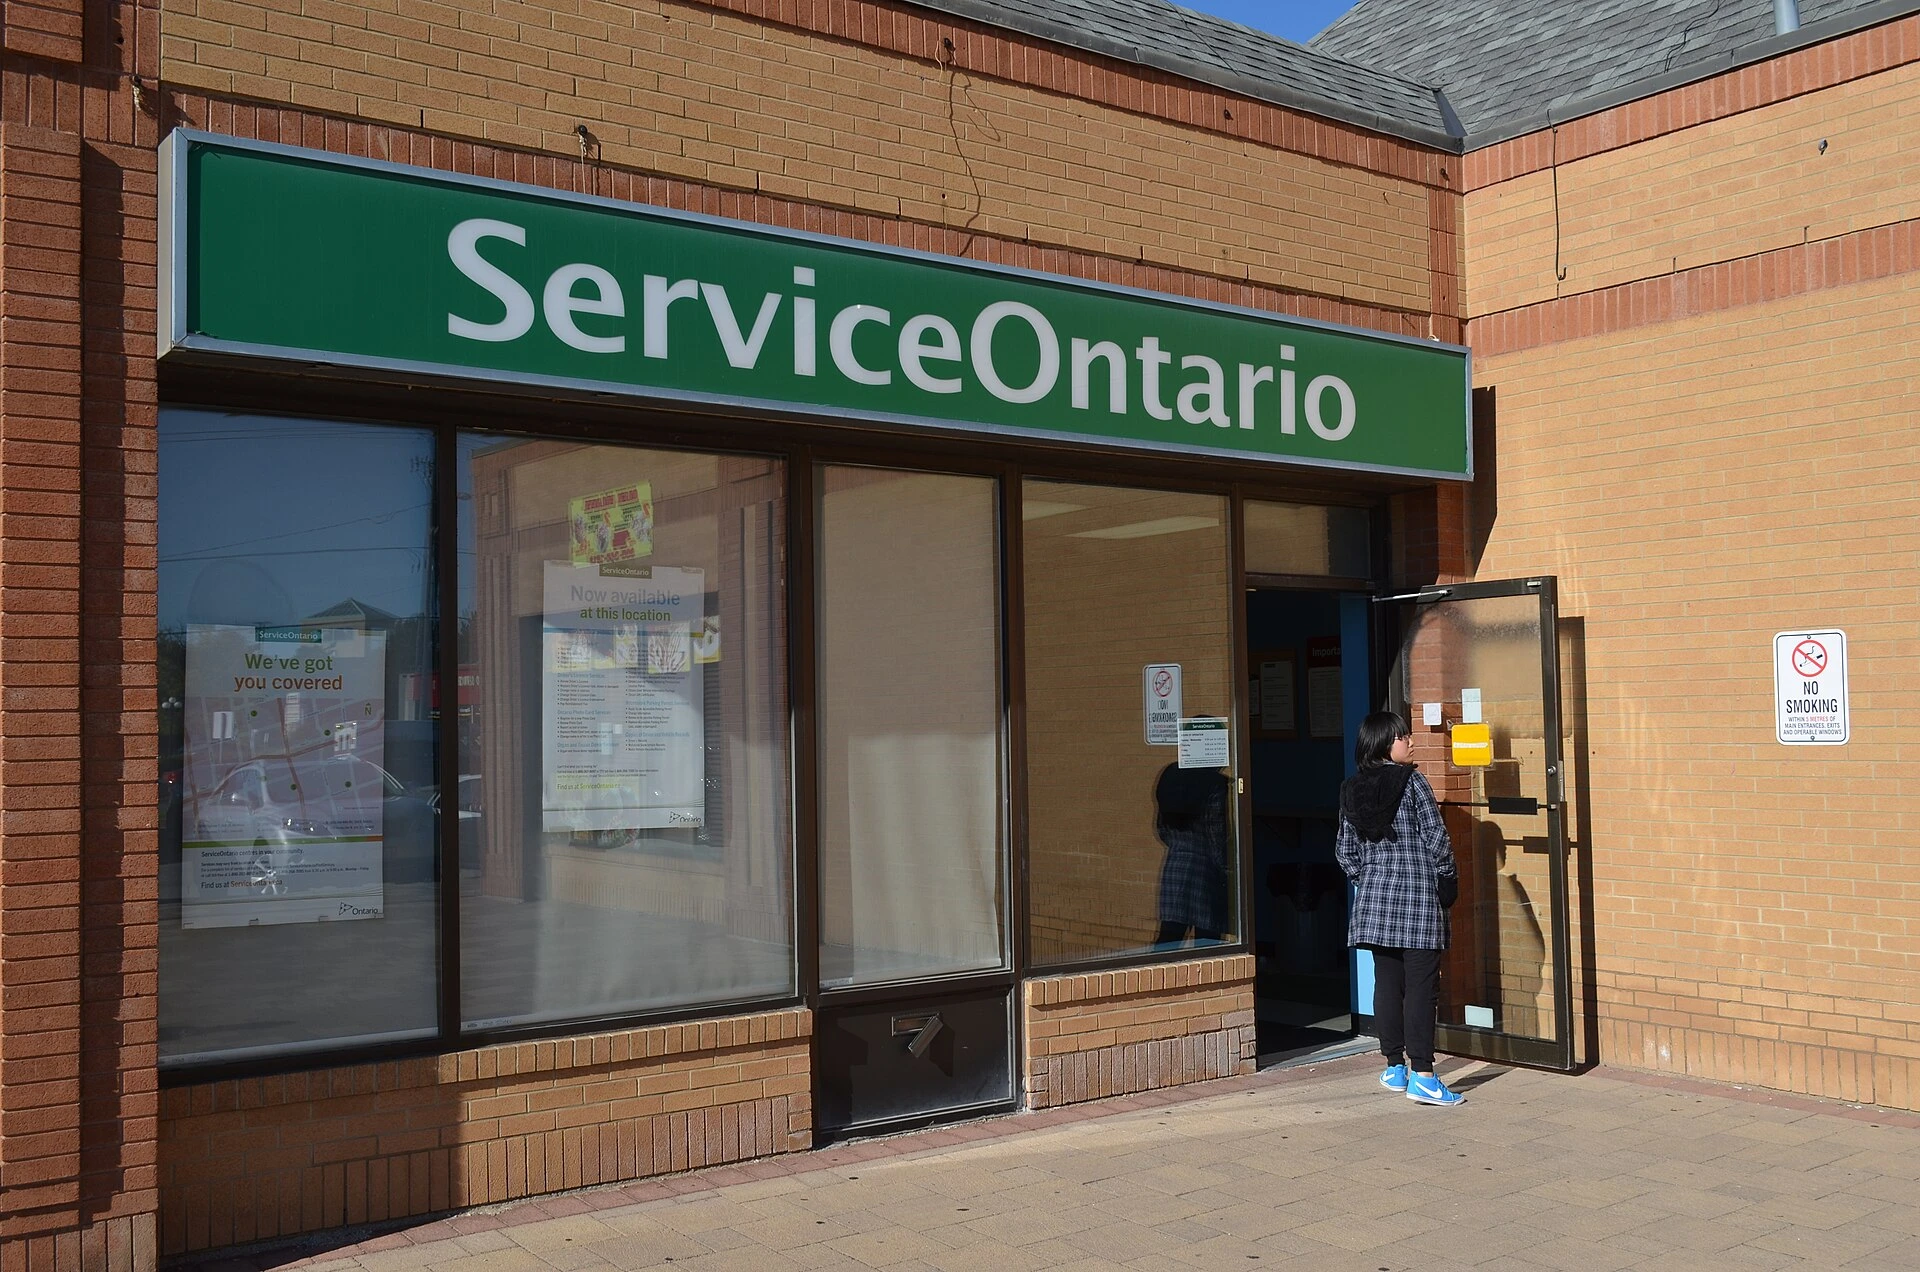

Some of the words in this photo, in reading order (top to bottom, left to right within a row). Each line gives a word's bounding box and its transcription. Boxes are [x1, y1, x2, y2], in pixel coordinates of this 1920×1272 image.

[447, 218, 1357, 442] ServiceOntario
[602, 567, 649, 576] ServiceOntario
[571, 585, 607, 602] Now
[611, 589, 680, 606] available
[580, 607, 593, 619] at
[596, 607, 619, 620] this
[622, 608, 671, 621] location
[259, 630, 318, 640] ServiceOntario
[245, 653, 300, 670] We've
[305, 656, 333, 674] got
[234, 676, 267, 692] you
[272, 675, 343, 690] covered
[1803, 681, 1819, 695] NO
[1786, 698, 1838, 713] SMOKING
[201, 850, 238, 858] ServiceOntario
[201, 881, 214, 889] Find
[215, 881, 222, 889] us
[352, 906, 379, 916] Ontario
